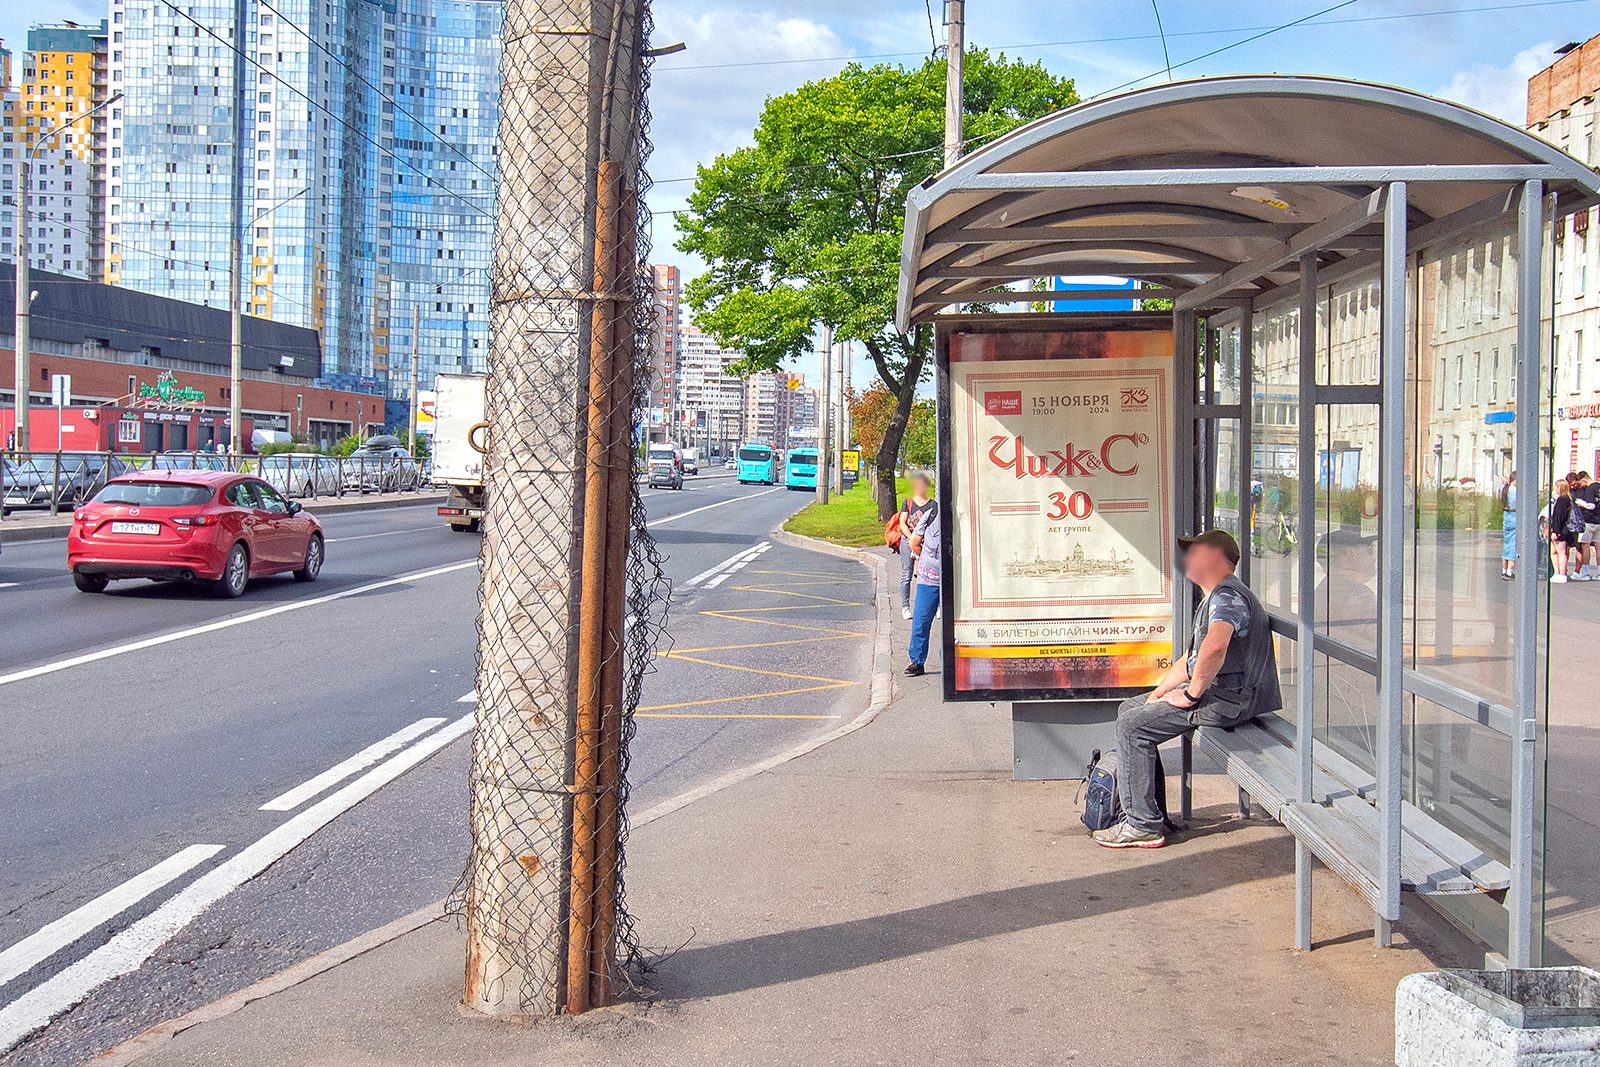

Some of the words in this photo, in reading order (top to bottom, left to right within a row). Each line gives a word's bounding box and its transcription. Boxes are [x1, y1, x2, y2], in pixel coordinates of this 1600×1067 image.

[1032, 397, 1046, 407] 15
[1050, 395, 1109, 407] НОЯБРЯ
[1089, 406, 1110, 414] 2024
[1046, 490, 1094, 521] 30
[1063, 525, 1092, 533] ГРУППЕ
[993, 628, 1039, 638] БИЛЕТЫ
[1041, 626, 1090, 637] ОНЛАЙН
[1092, 625, 1166, 635] ЧИЖ-ТУР.РФ
